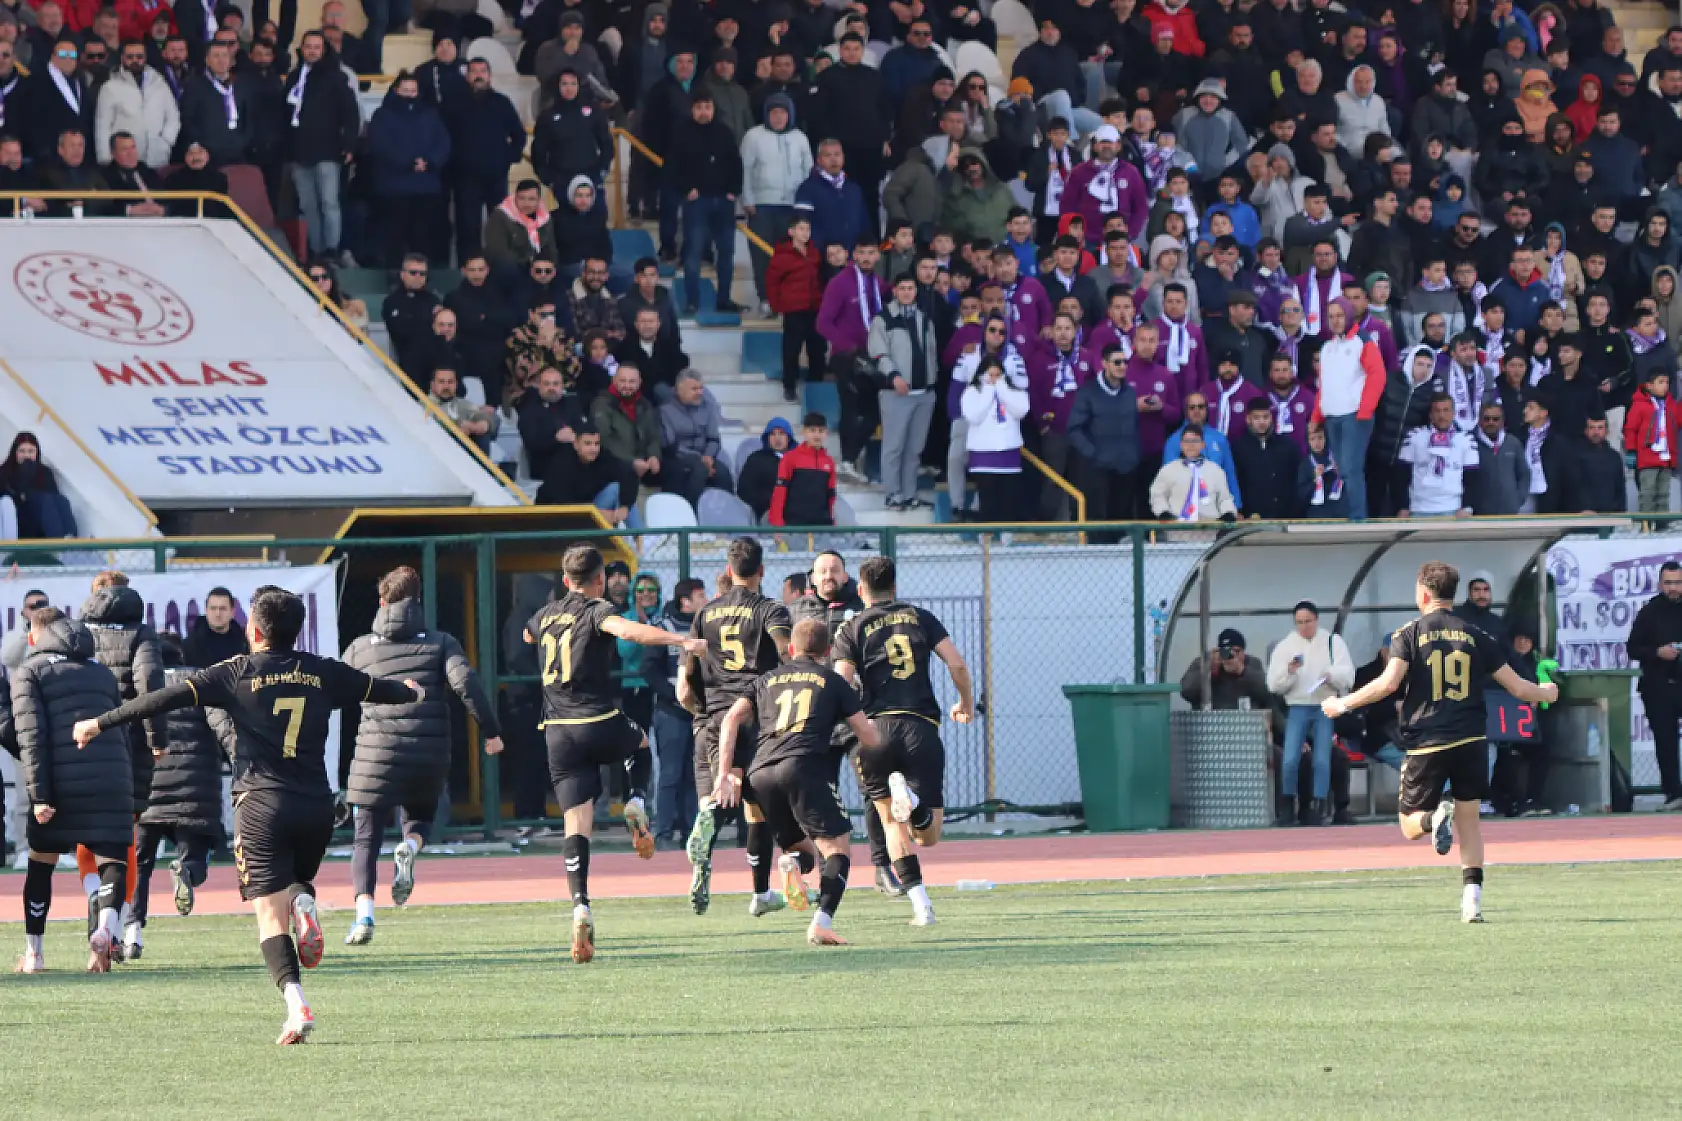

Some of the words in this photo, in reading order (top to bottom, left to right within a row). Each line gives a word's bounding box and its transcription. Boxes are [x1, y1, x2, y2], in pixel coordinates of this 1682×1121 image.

[93, 354, 268, 386] MİLAS
[152, 394, 268, 424] ŞEHİT
[237, 421, 390, 446] ÖZCAN
[157, 455, 384, 475] STADYUMU
[541, 629, 573, 687] 21
[720, 624, 746, 671] 5
[885, 633, 916, 680] 9
[1426, 649, 1471, 702] 19
[273, 697, 306, 758] 7
[775, 688, 813, 737] 11
[1499, 705, 1533, 738] 12
